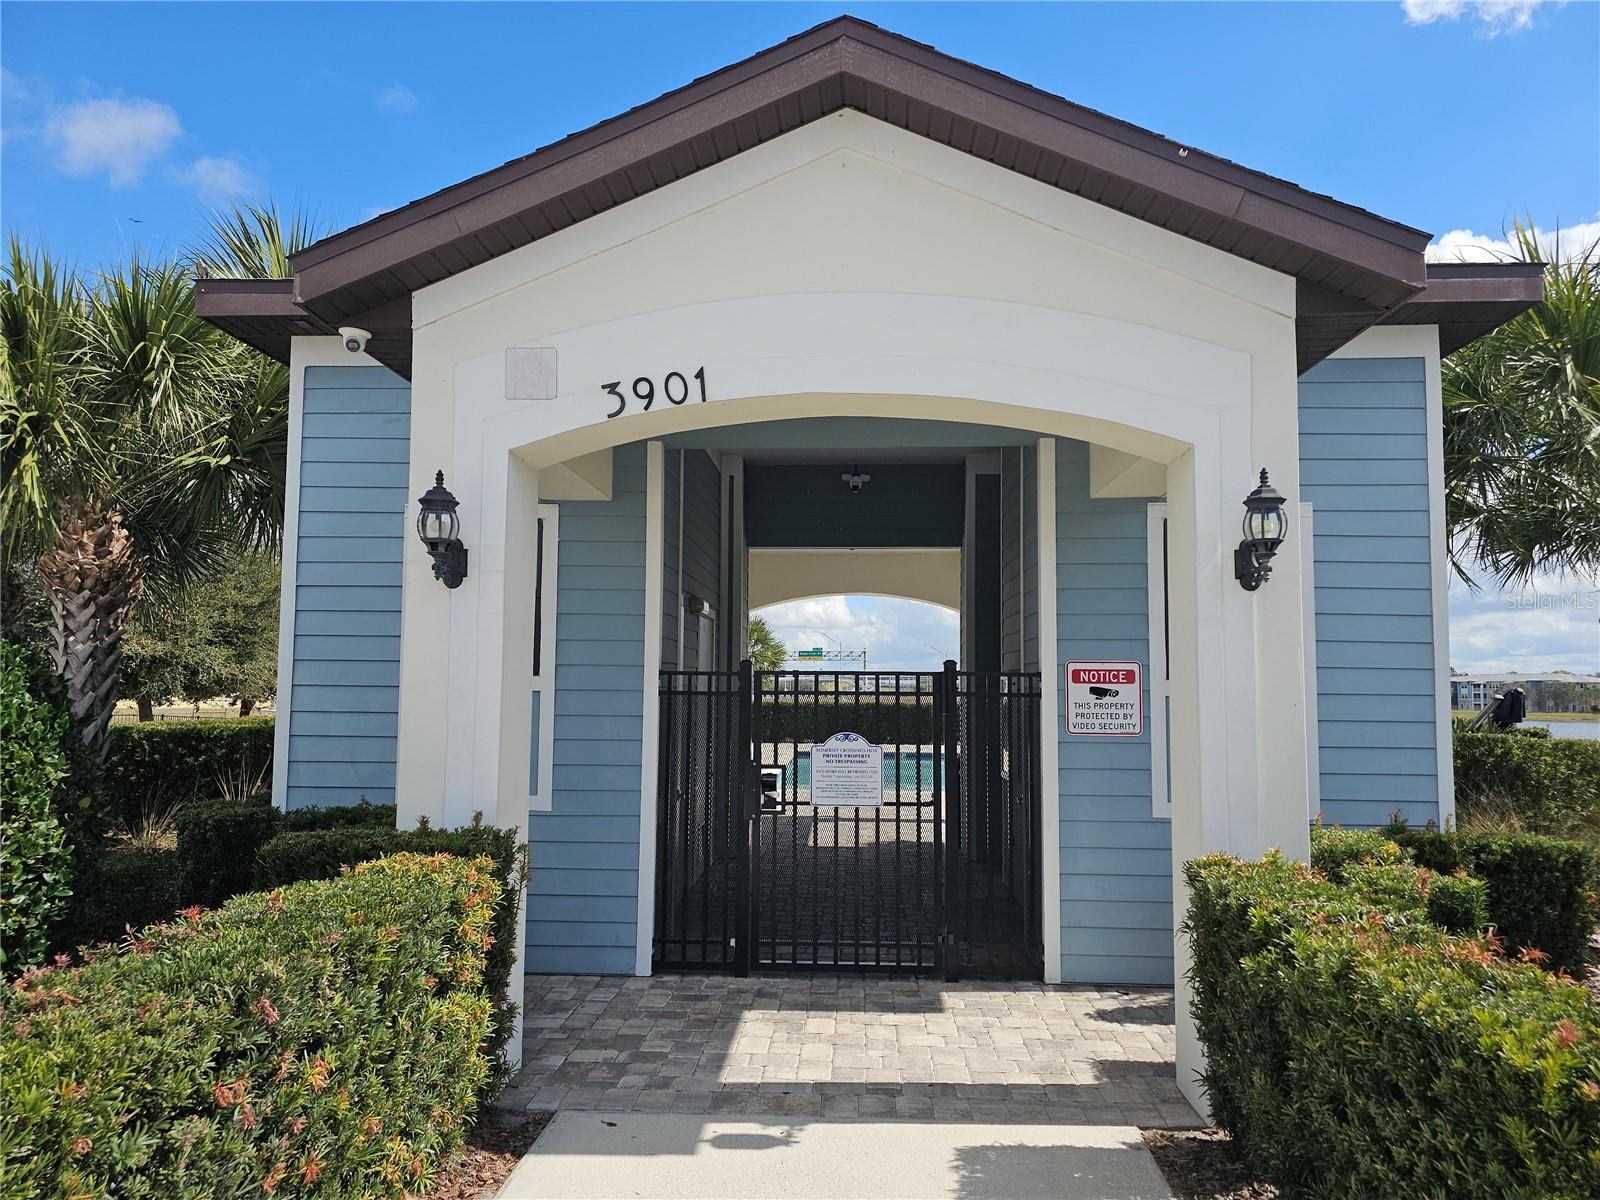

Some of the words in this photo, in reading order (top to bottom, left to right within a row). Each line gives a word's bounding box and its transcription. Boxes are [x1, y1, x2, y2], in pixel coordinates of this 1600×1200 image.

[601, 366, 707, 418] 3901
[1080, 671, 1127, 682] NOTICE
[1074, 702, 1091, 710] THIS
[1093, 702, 1135, 710] PROPERTY
[1075, 712, 1120, 720] PROTECTED
[1072, 722, 1096, 730] VIDEO
[1098, 722, 1137, 730] SECURITY
